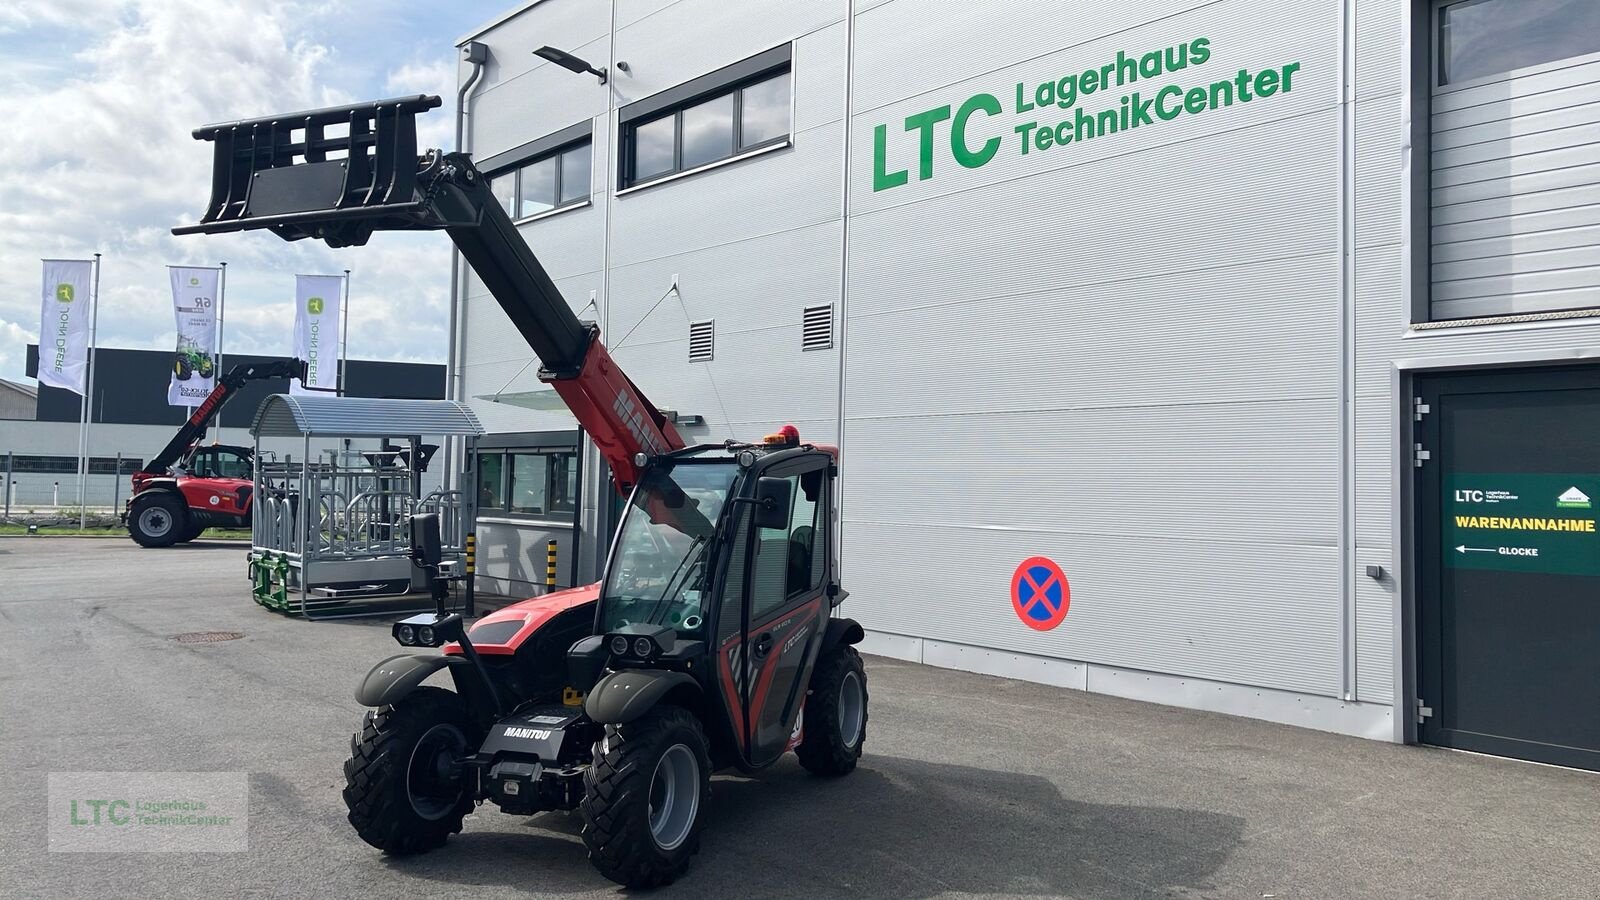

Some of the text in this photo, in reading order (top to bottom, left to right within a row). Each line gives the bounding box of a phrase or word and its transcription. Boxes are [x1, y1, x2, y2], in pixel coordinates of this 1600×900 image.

[1015, 37, 1211, 114] Lagerhaus
[1014, 62, 1301, 155] TechnikCenter
[873, 93, 1003, 193] LTC
[191, 384, 226, 426] MANITOU
[1455, 489, 1483, 502] LTC
[1455, 516, 1596, 532] WARENANNAHME
[1498, 547, 1538, 556] GLOCKE
[503, 727, 552, 740] MANITOU
